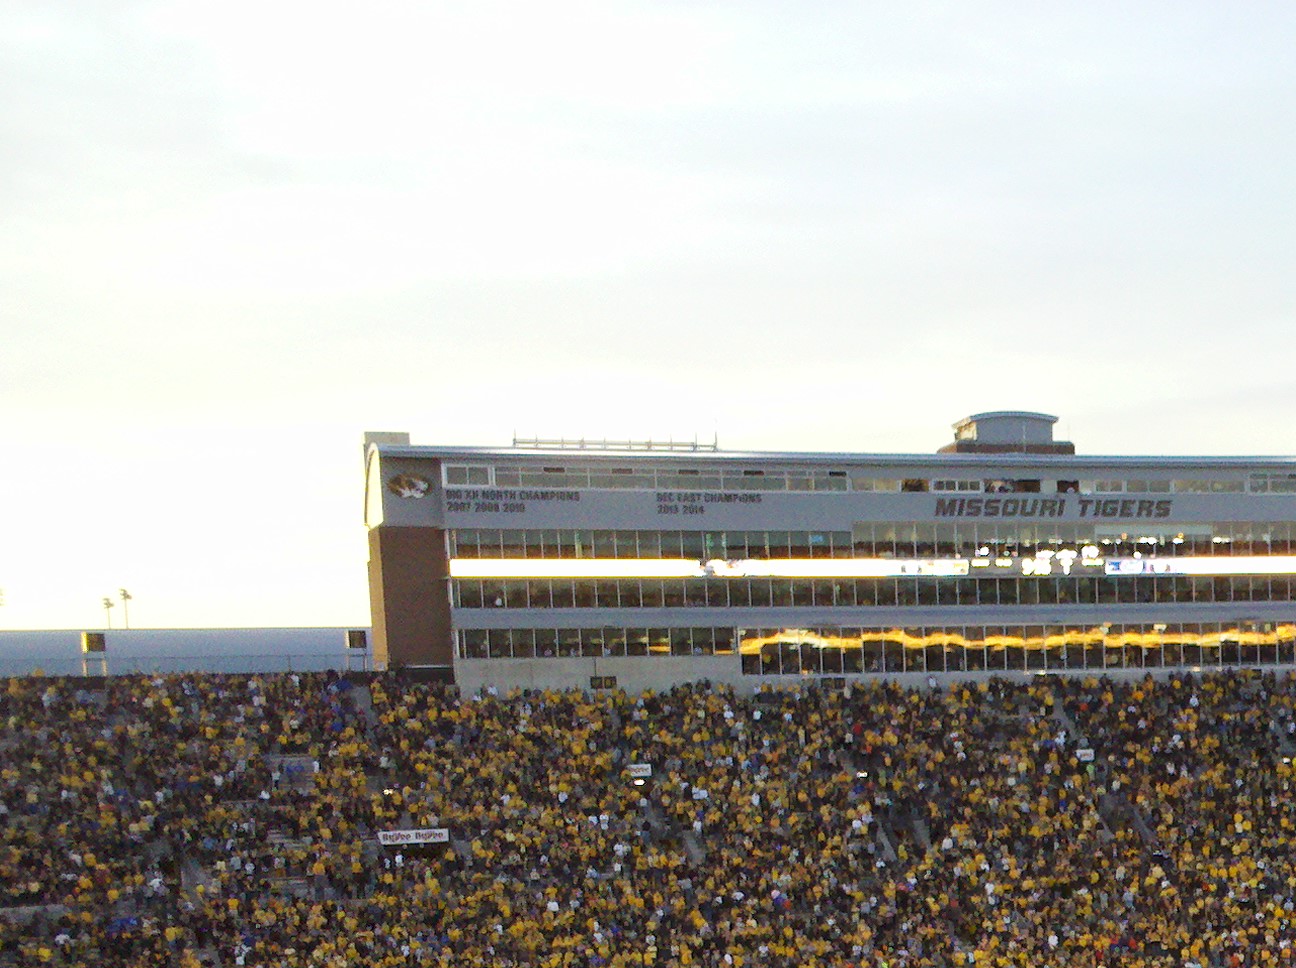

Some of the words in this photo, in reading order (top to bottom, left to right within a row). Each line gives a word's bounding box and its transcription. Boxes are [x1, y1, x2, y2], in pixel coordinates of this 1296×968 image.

[481, 490, 517, 501] NORTH
[519, 491, 580, 502] CHAMPIONS
[677, 492, 701, 502] EAST
[703, 492, 762, 503] CHAMPIONS
[934, 498, 1067, 518] MISSOURI
[1077, 499, 1173, 518] TIGERS
